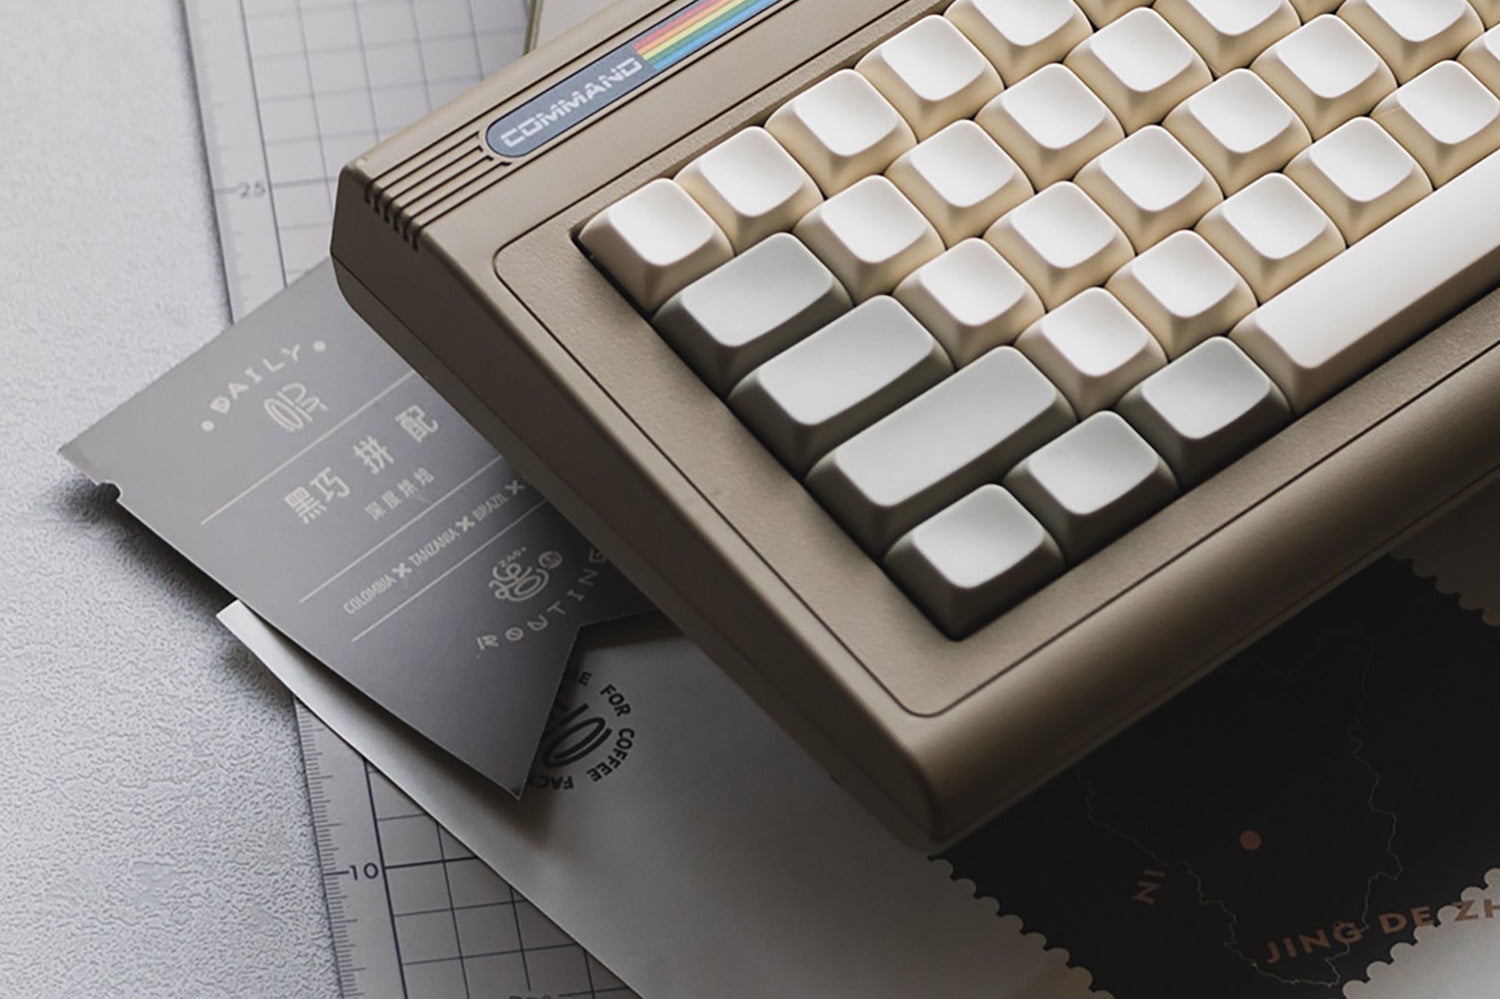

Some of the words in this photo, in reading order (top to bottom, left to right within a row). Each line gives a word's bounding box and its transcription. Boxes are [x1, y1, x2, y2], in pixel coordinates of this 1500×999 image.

[500, 57, 642, 149] COMMAND
[239, 181, 267, 198] 25
[209, 344, 301, 414] DAILY
[343, 574, 397, 615] COLOMBIA
[408, 528, 460, 567] TANZANIA
[472, 492, 508, 522] BRAZIL
[600, 684, 631, 717] FOR
[586, 728, 635, 782] COFFEE
[348, 862, 379, 880] 10
[1266, 921, 1363, 964] JING
[1379, 905, 1434, 935] DE
